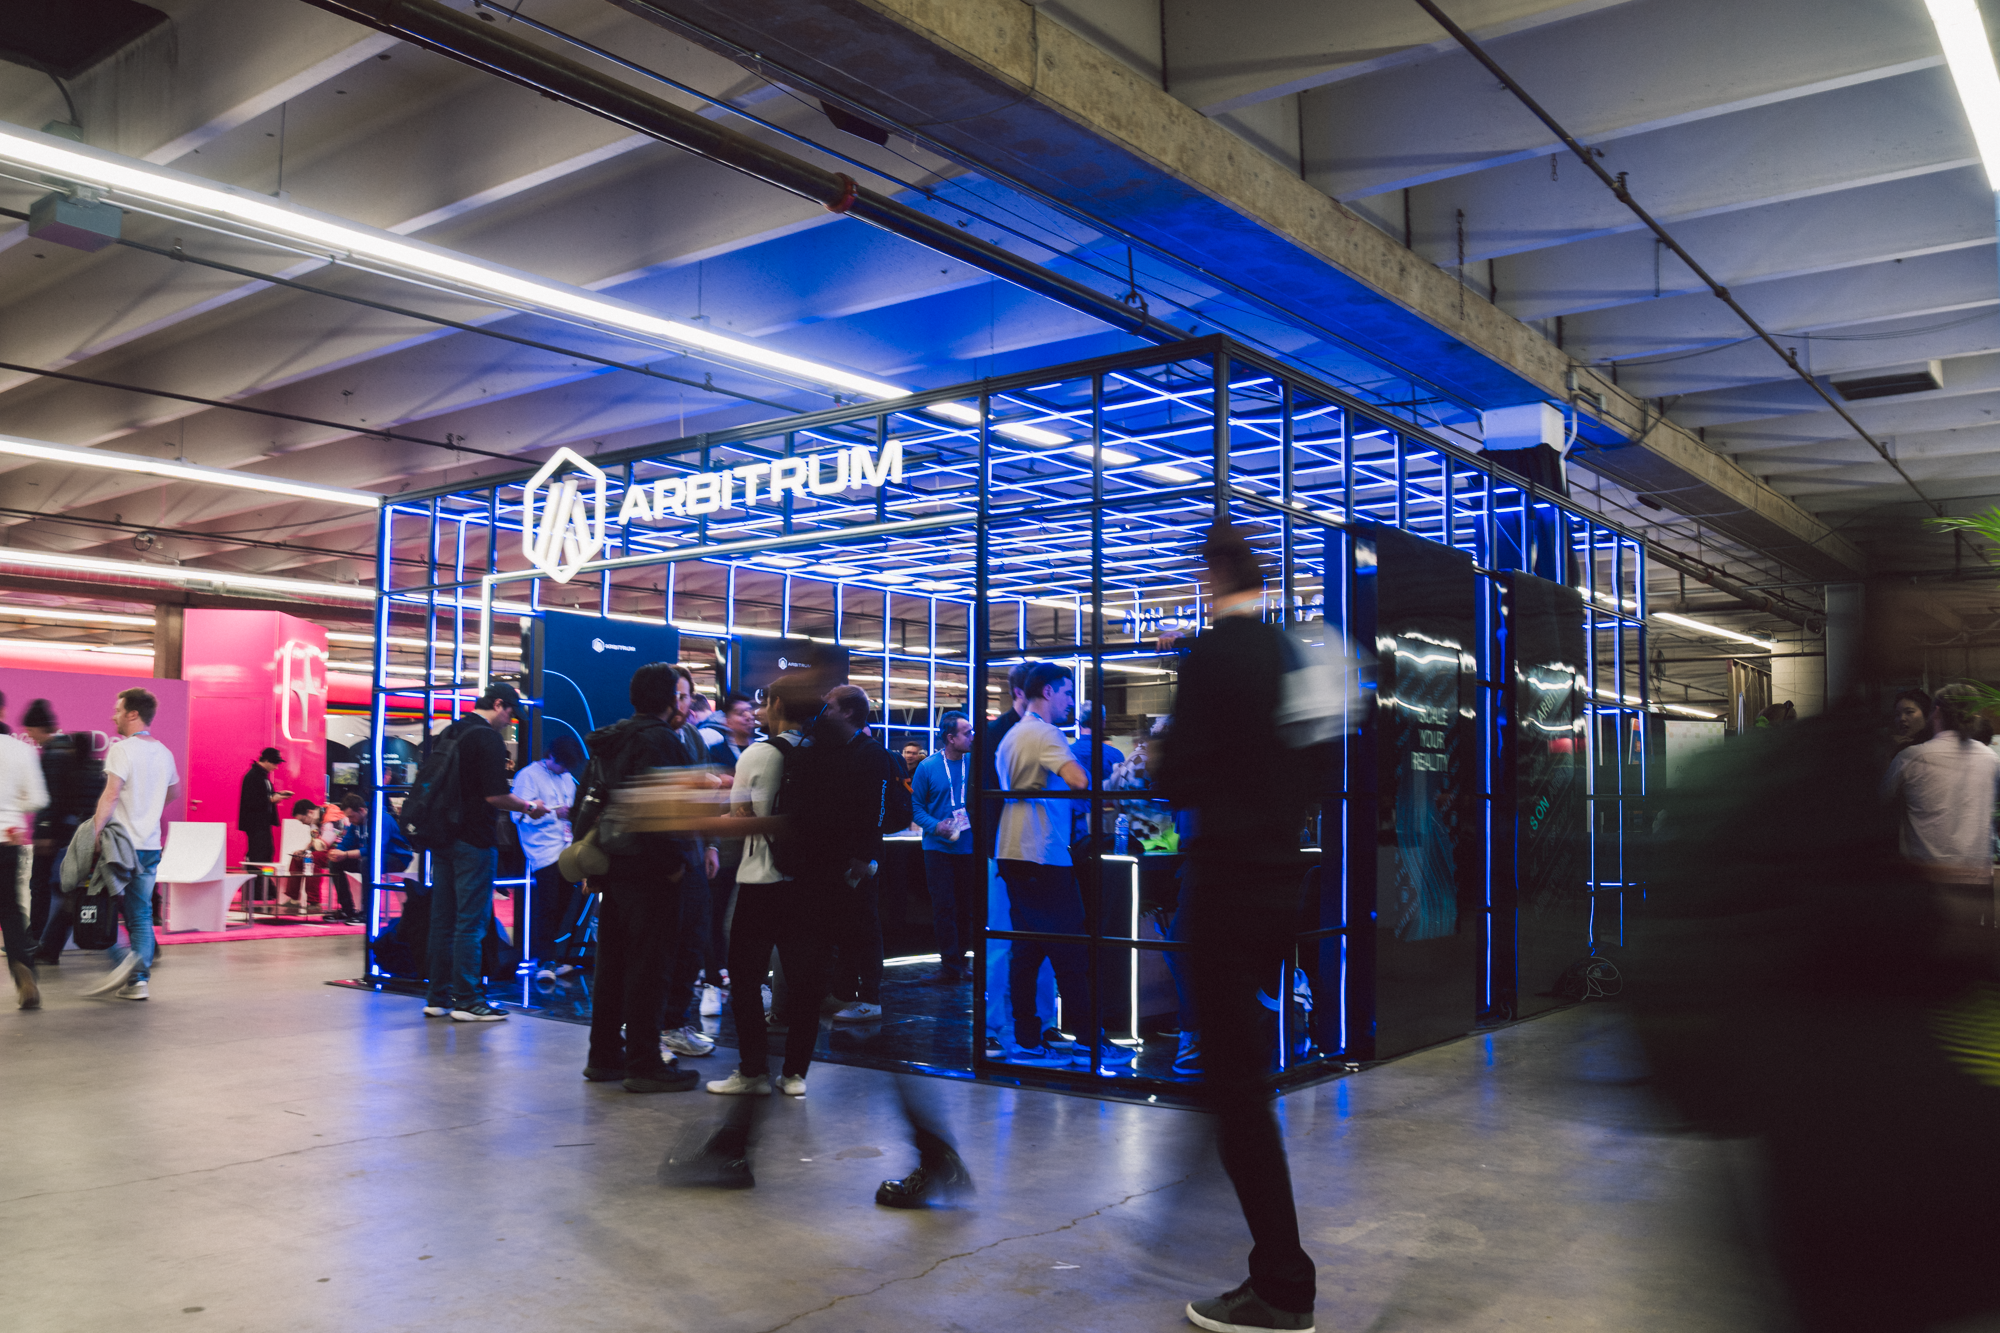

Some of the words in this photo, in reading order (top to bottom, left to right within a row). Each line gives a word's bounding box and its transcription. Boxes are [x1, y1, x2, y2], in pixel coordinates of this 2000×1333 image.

[617, 440, 903, 525] ARBITRUM
[1418, 729, 1445, 749] YOUR
[1411, 751, 1450, 772] REALITY
